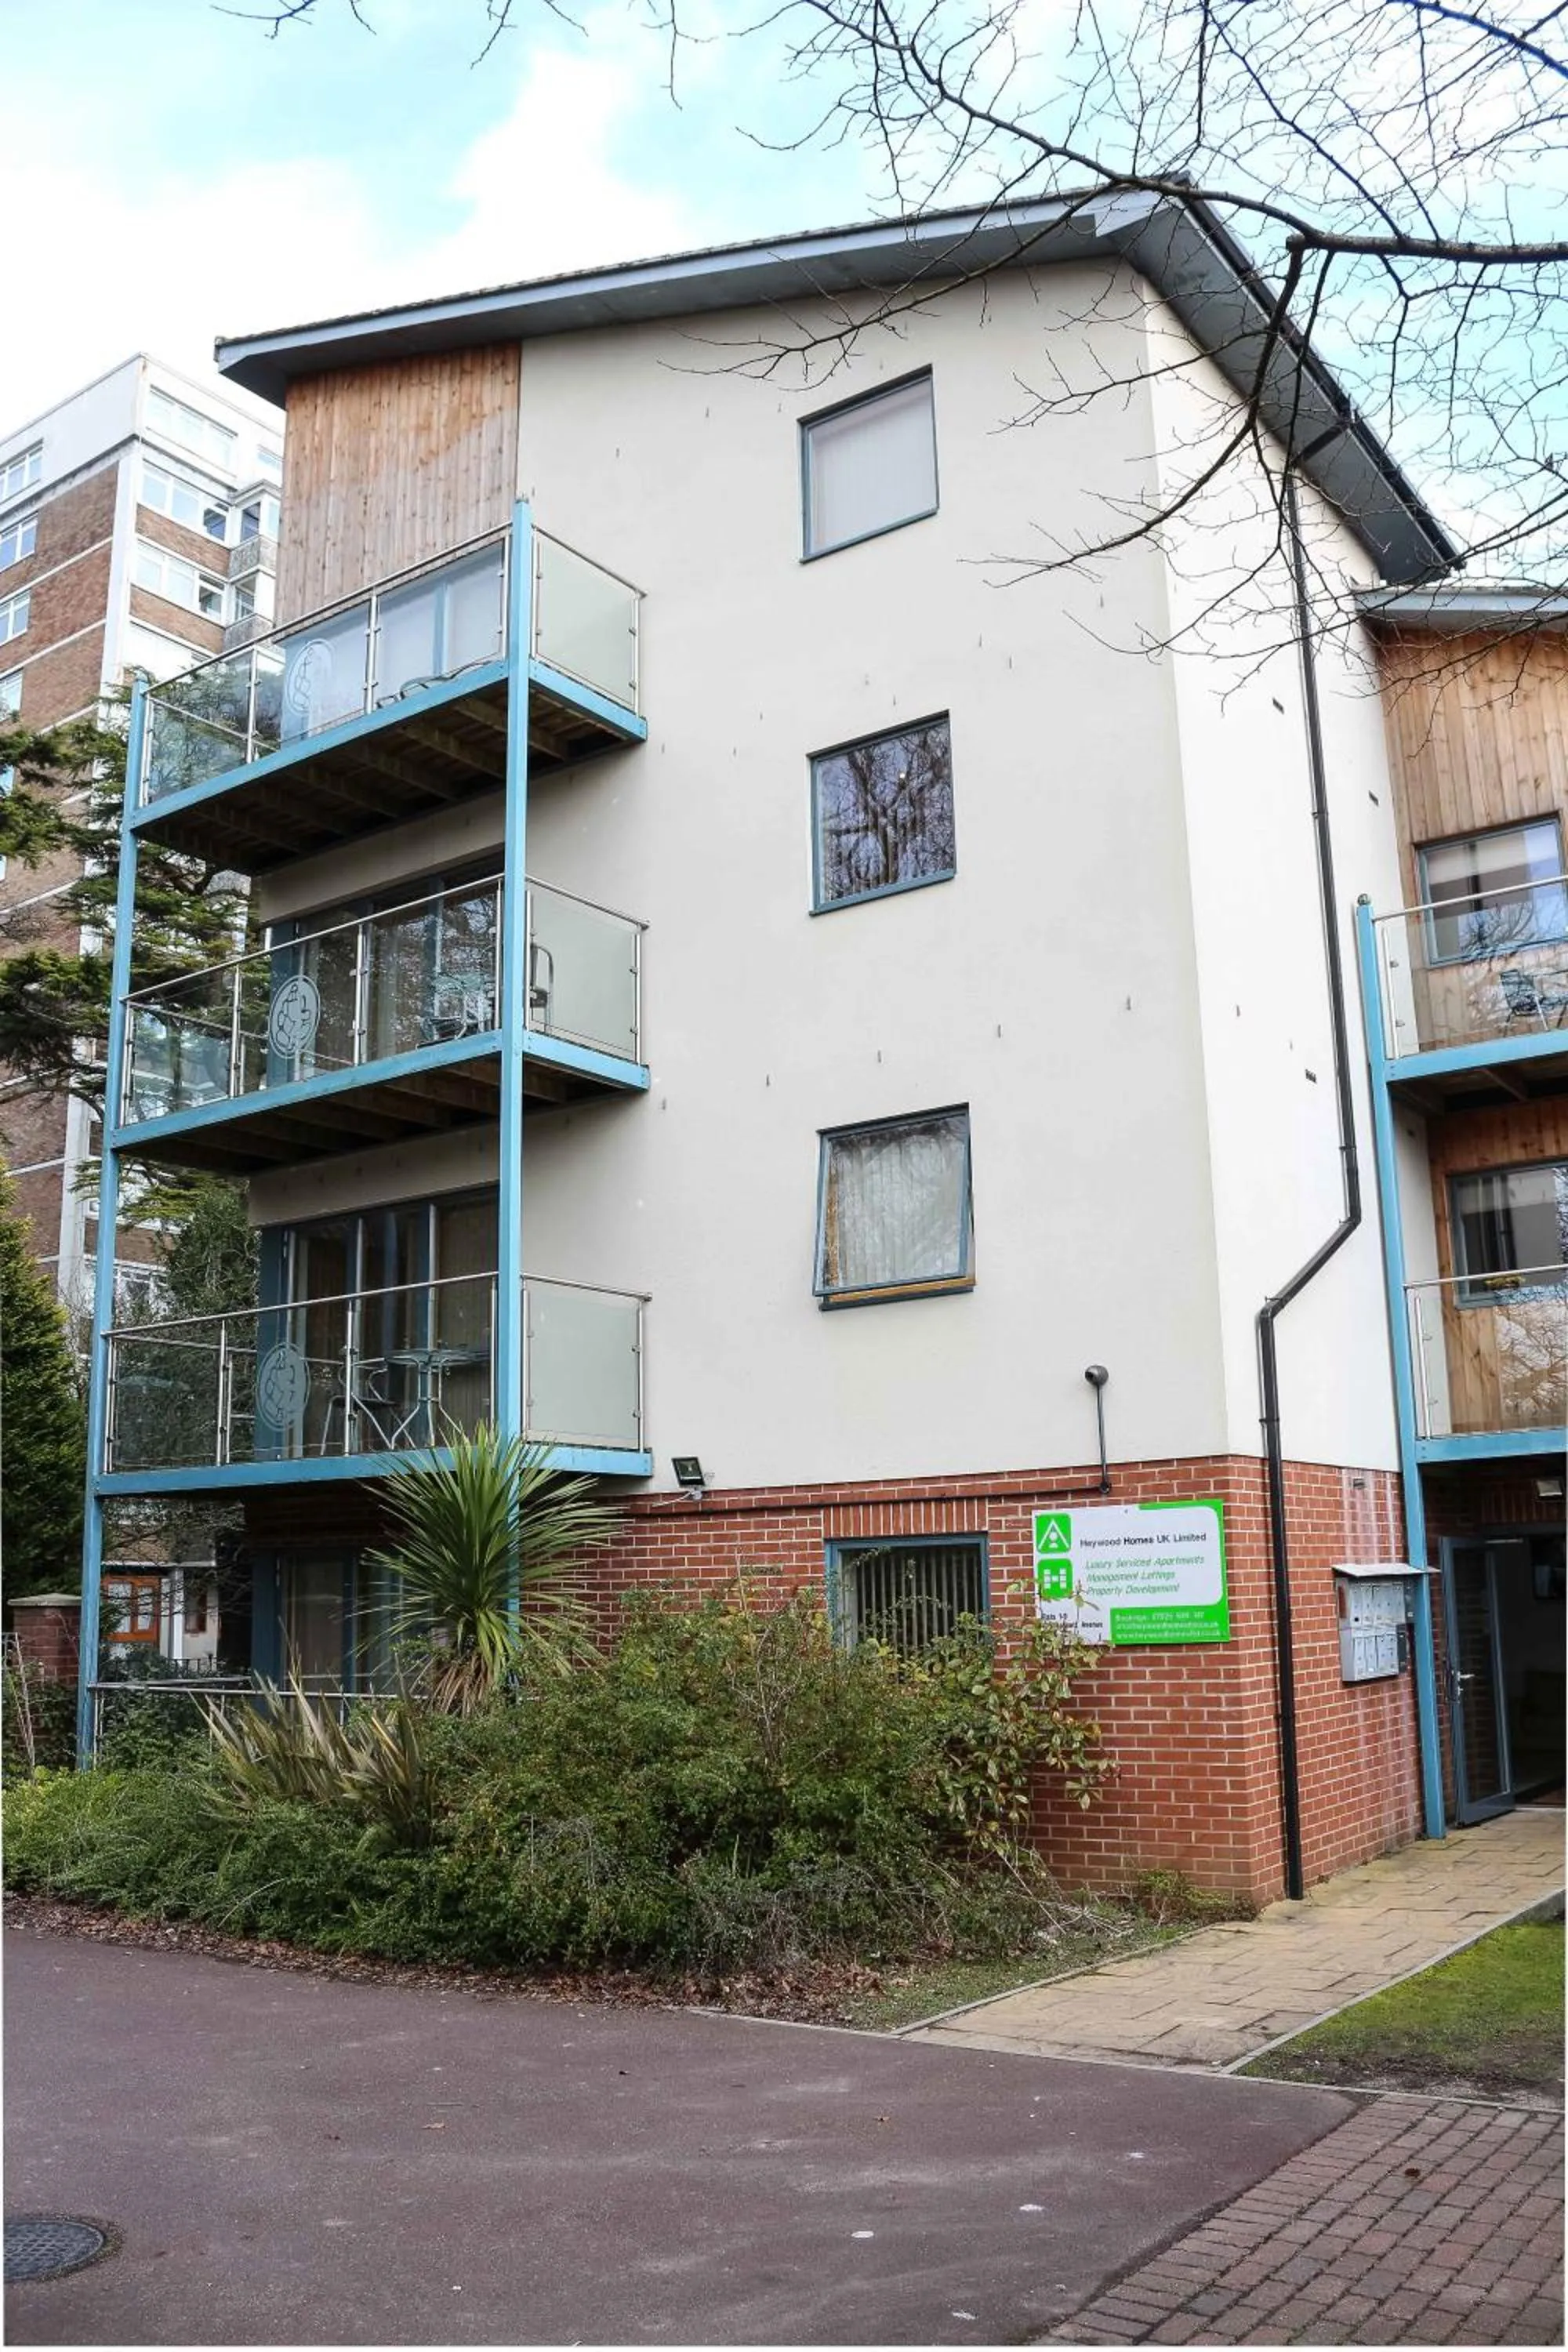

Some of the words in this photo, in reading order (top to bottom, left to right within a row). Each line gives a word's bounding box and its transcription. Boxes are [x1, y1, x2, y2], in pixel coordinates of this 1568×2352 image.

[1080, 1537, 1121, 1548] Heywood
[1123, 1537, 1153, 1545] Homes
[1156, 1534, 1169, 1544] UK
[1173, 1534, 1207, 1543] Limited
[1085, 1560, 1112, 1570] Luxury
[1116, 1557, 1151, 1567] Serviced
[1154, 1555, 1205, 1567] Apartments
[1087, 1571, 1138, 1581] Management
[1141, 1570, 1175, 1581] Lettings
[1087, 1585, 1122, 1596] Property
[1125, 1583, 1180, 1595] Development
